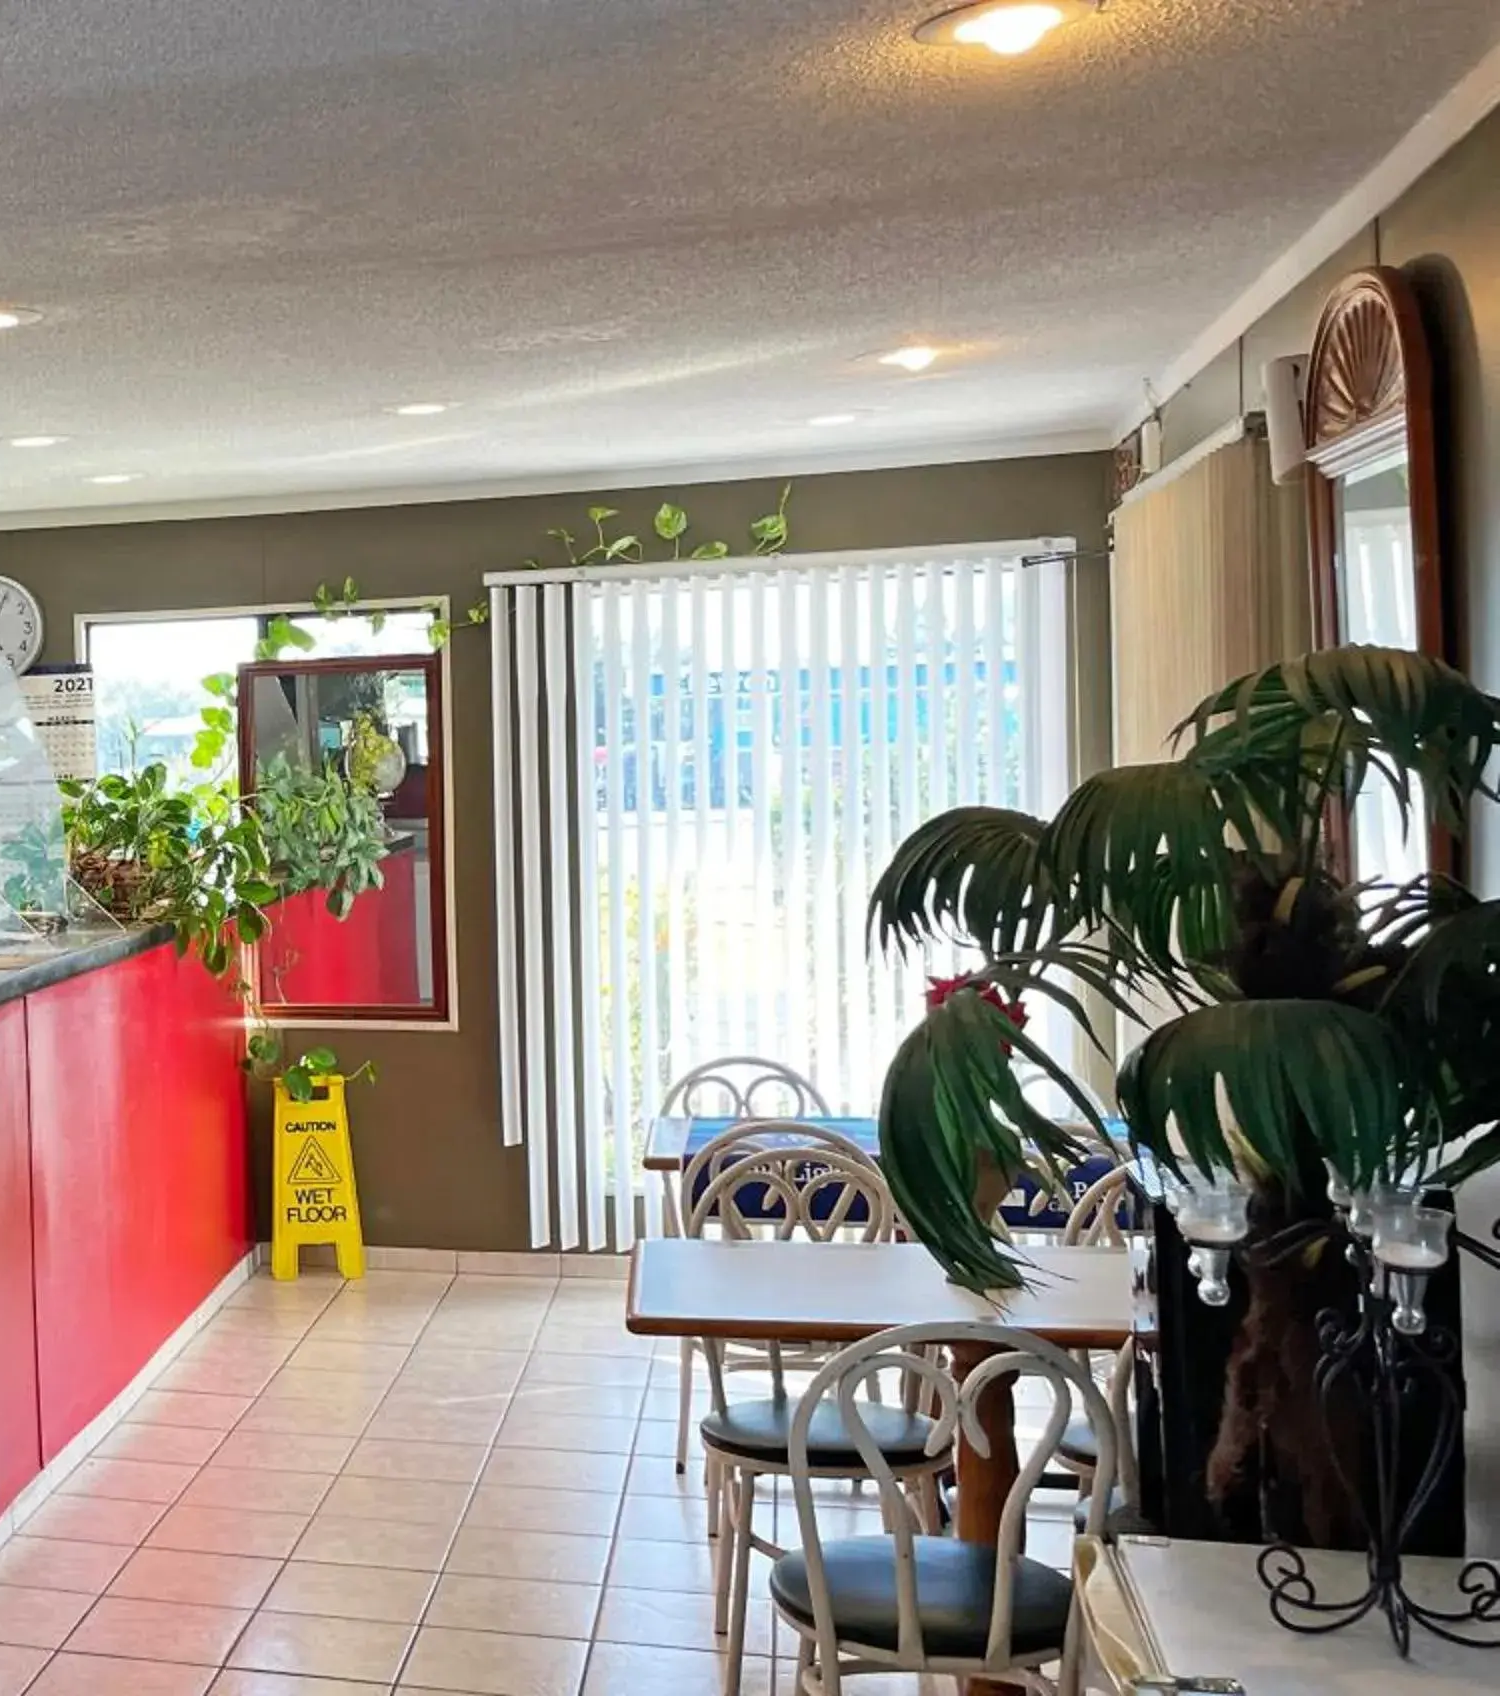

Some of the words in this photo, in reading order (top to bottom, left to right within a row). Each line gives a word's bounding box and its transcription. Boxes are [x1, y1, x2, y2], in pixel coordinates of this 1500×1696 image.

[17, 600, 26, 615] 2
[23, 621, 33, 635] 3
[19, 640, 27, 651] 4
[54, 678, 93, 693] 2021
[285, 1121, 337, 1133] CAUTION
[294, 1187, 333, 1205] WET
[286, 1205, 347, 1223] FLOOR
